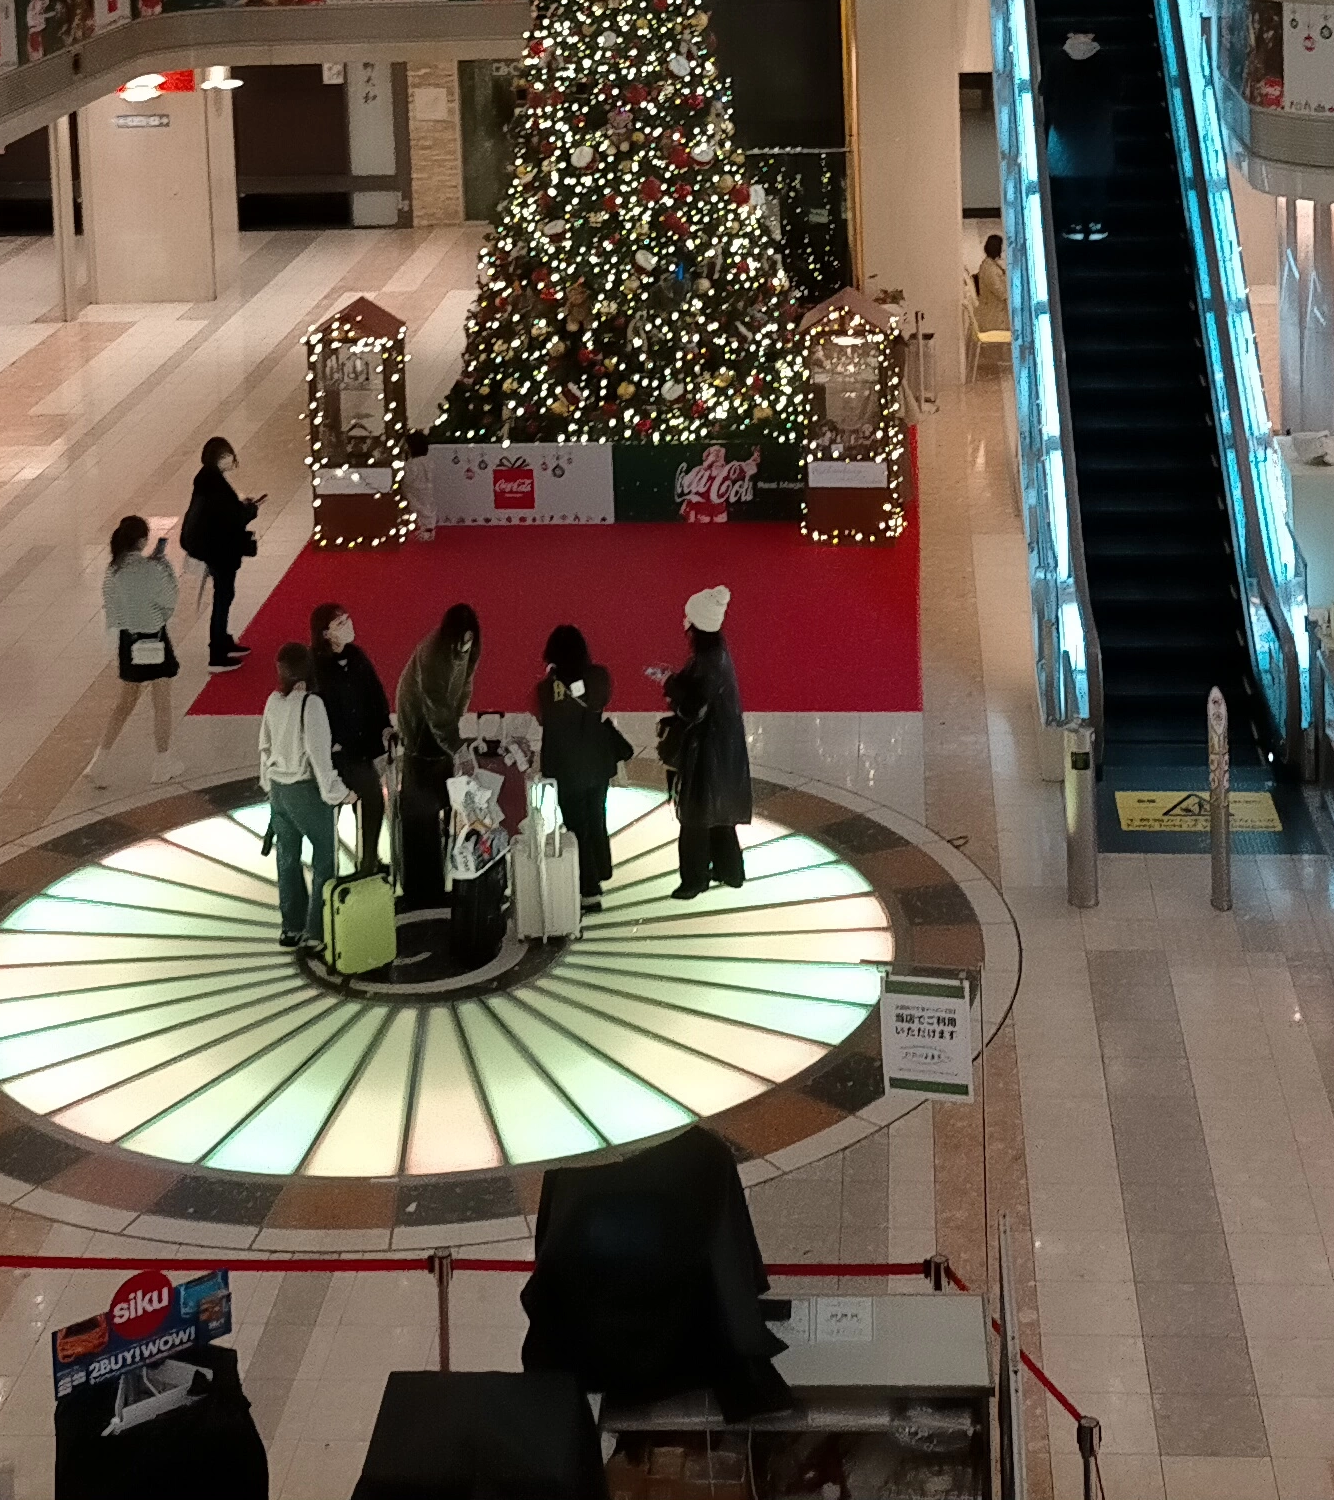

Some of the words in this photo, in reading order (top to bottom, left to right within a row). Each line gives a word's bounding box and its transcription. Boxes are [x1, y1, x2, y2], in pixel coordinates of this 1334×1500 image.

[895, 1012, 957, 1028] 当店でご利用
[895, 1025, 958, 1040] いただけます
[113, 1287, 169, 1324] siku
